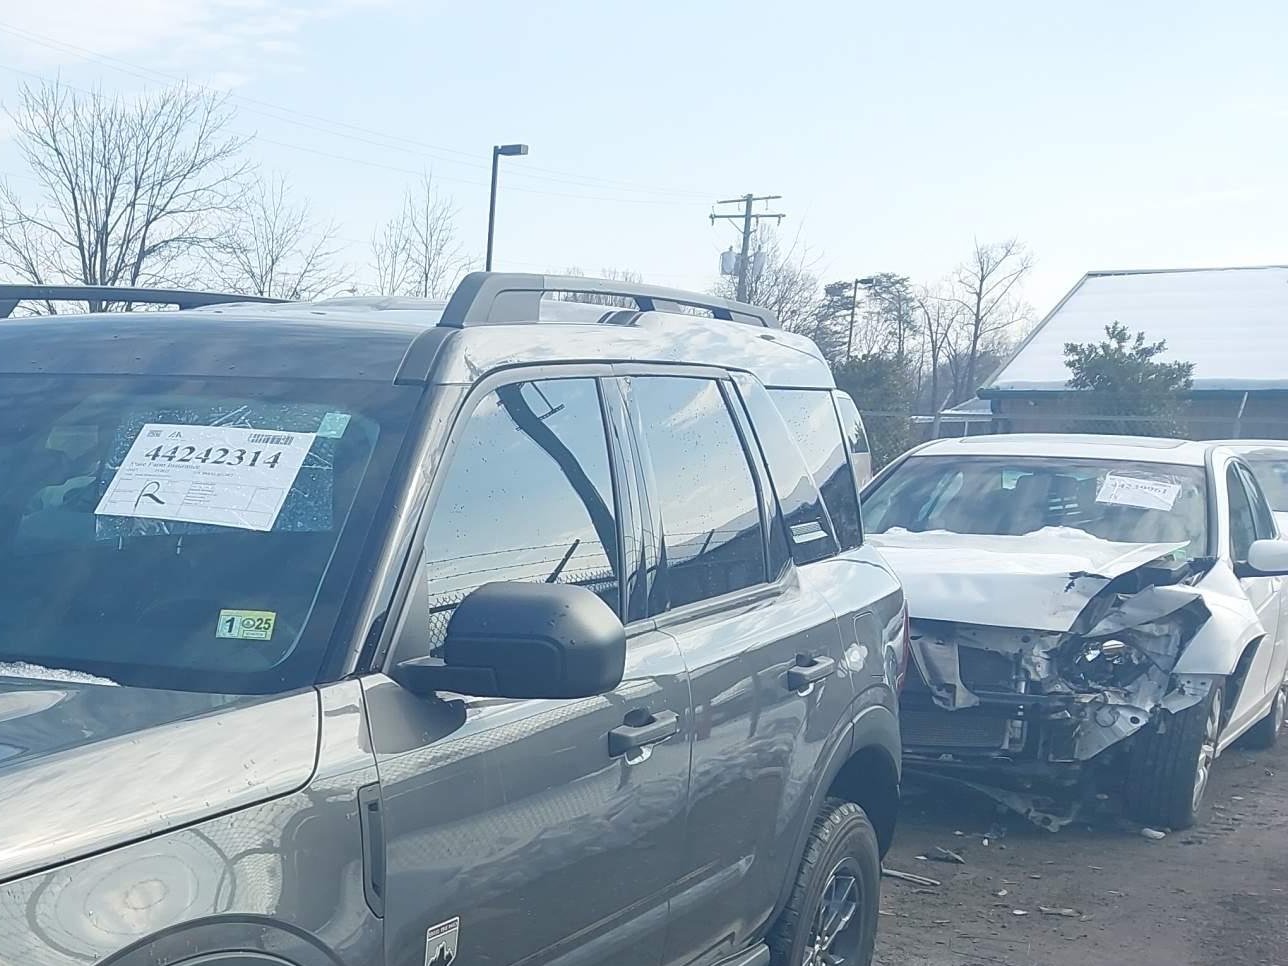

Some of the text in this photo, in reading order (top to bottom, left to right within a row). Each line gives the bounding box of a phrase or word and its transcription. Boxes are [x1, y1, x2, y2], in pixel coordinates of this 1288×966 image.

[144, 444, 282, 469] 44242314
[133, 481, 165, 511] R
[225, 616, 272, 633] 1 25
